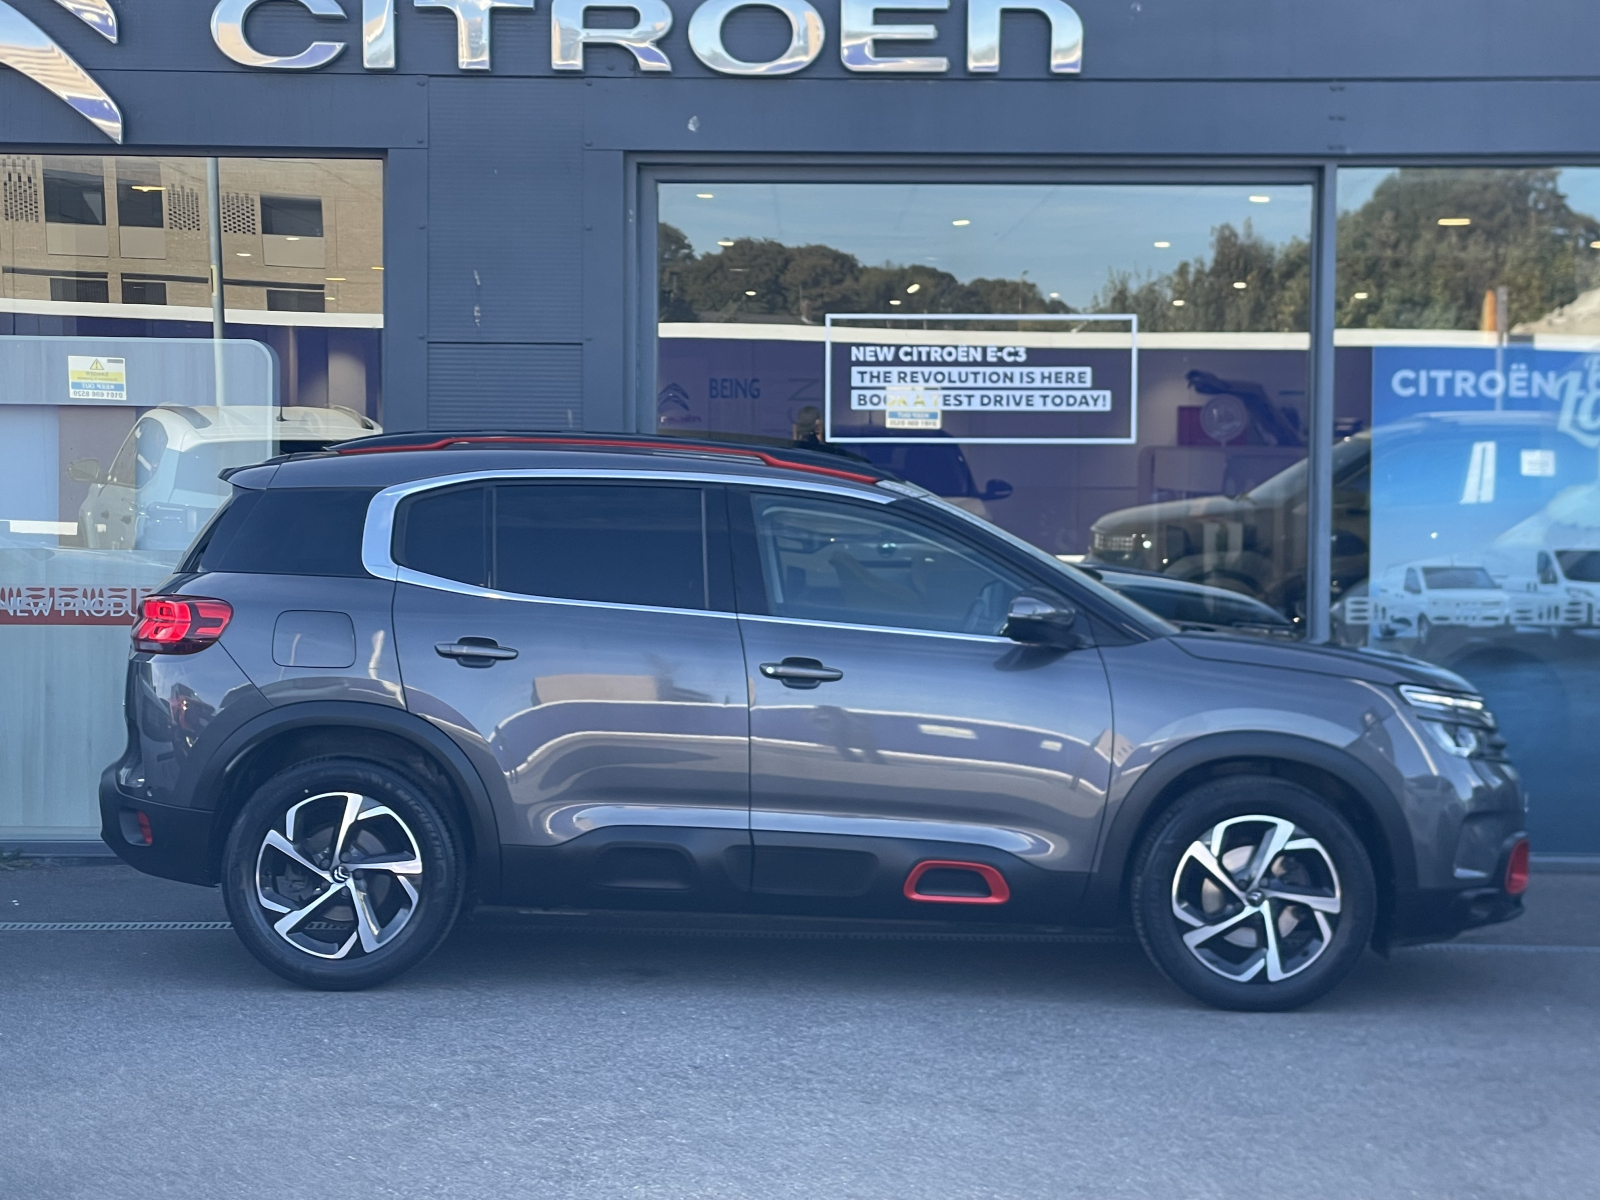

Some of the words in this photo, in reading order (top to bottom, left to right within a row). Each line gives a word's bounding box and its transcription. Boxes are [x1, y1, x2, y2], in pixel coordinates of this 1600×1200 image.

[851, 346, 895, 362] NEW
[857, 371, 892, 383] THE
[897, 371, 1014, 384] REVOLUTION
[1019, 371, 1035, 384] IS
[1040, 371, 1087, 384] HERE
[1391, 362, 1558, 398] CITROËN
[709, 378, 761, 399] BEING
[980, 394, 1035, 407] DRIVE
[1040, 394, 1107, 408] TODAY!
[395, 788, 445, 861] MICHELIN
